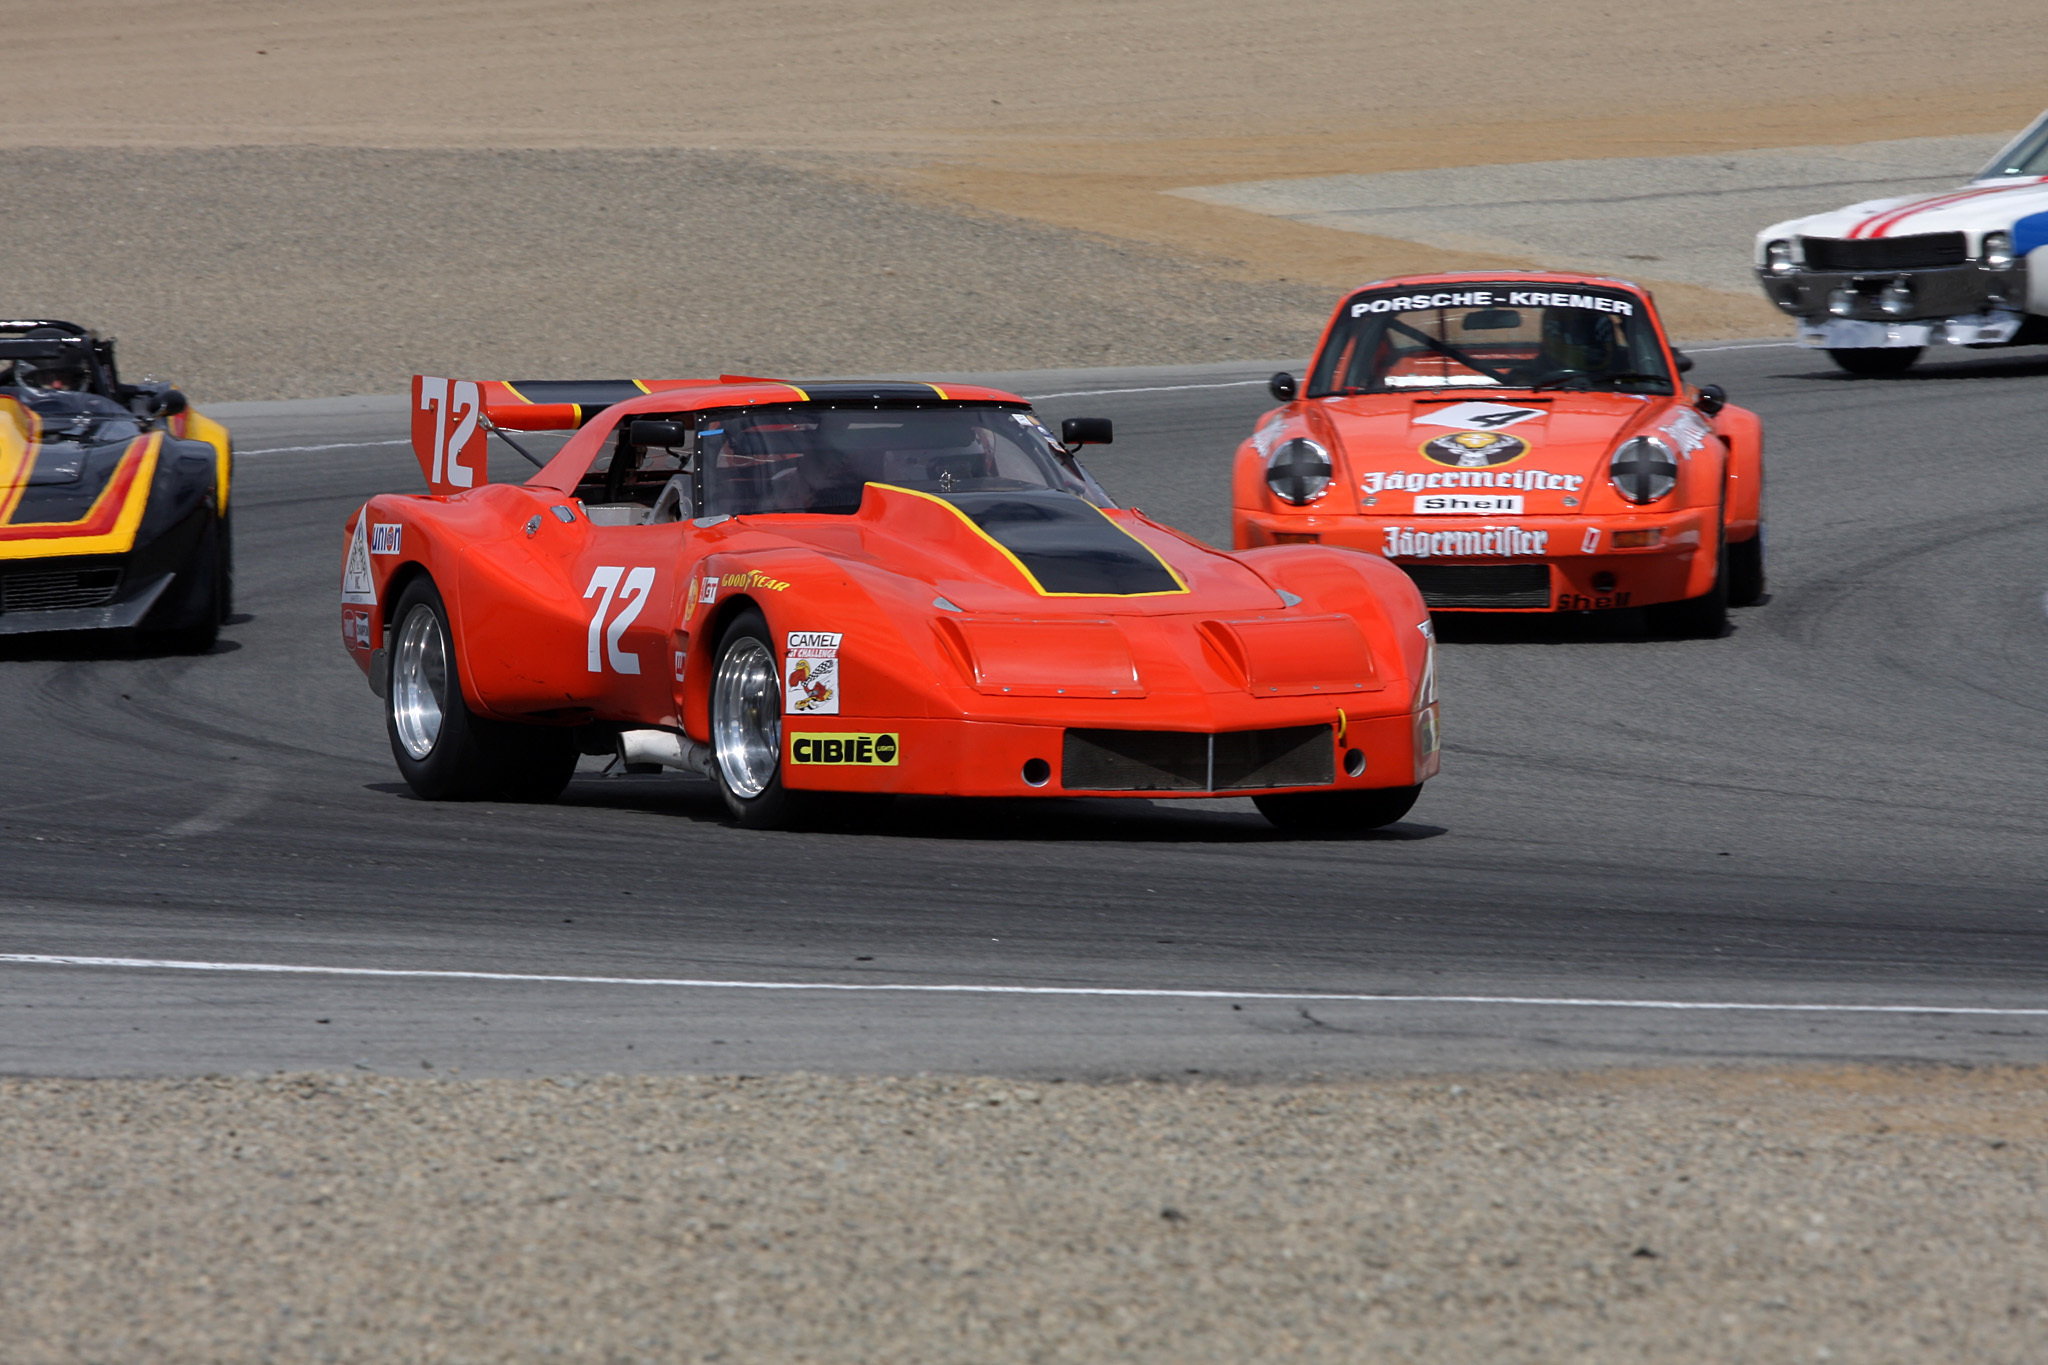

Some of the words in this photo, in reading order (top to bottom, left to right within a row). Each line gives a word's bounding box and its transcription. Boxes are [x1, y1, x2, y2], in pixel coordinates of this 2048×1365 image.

[1352, 292, 1633, 318] PORSCHE-KREMER
[1469, 410, 1538, 428] 4
[421, 376, 480, 488] 72
[1361, 469, 1584, 493] Jägermeister
[1425, 498, 1513, 509] Shell
[372, 526, 401, 551] UNION
[1382, 526, 1549, 558] Jägermeister
[1559, 592, 1631, 609] Shell
[583, 566, 656, 675] 72
[789, 634, 838, 647] CAMEL
[797, 649, 836, 658] CHALLENGE
